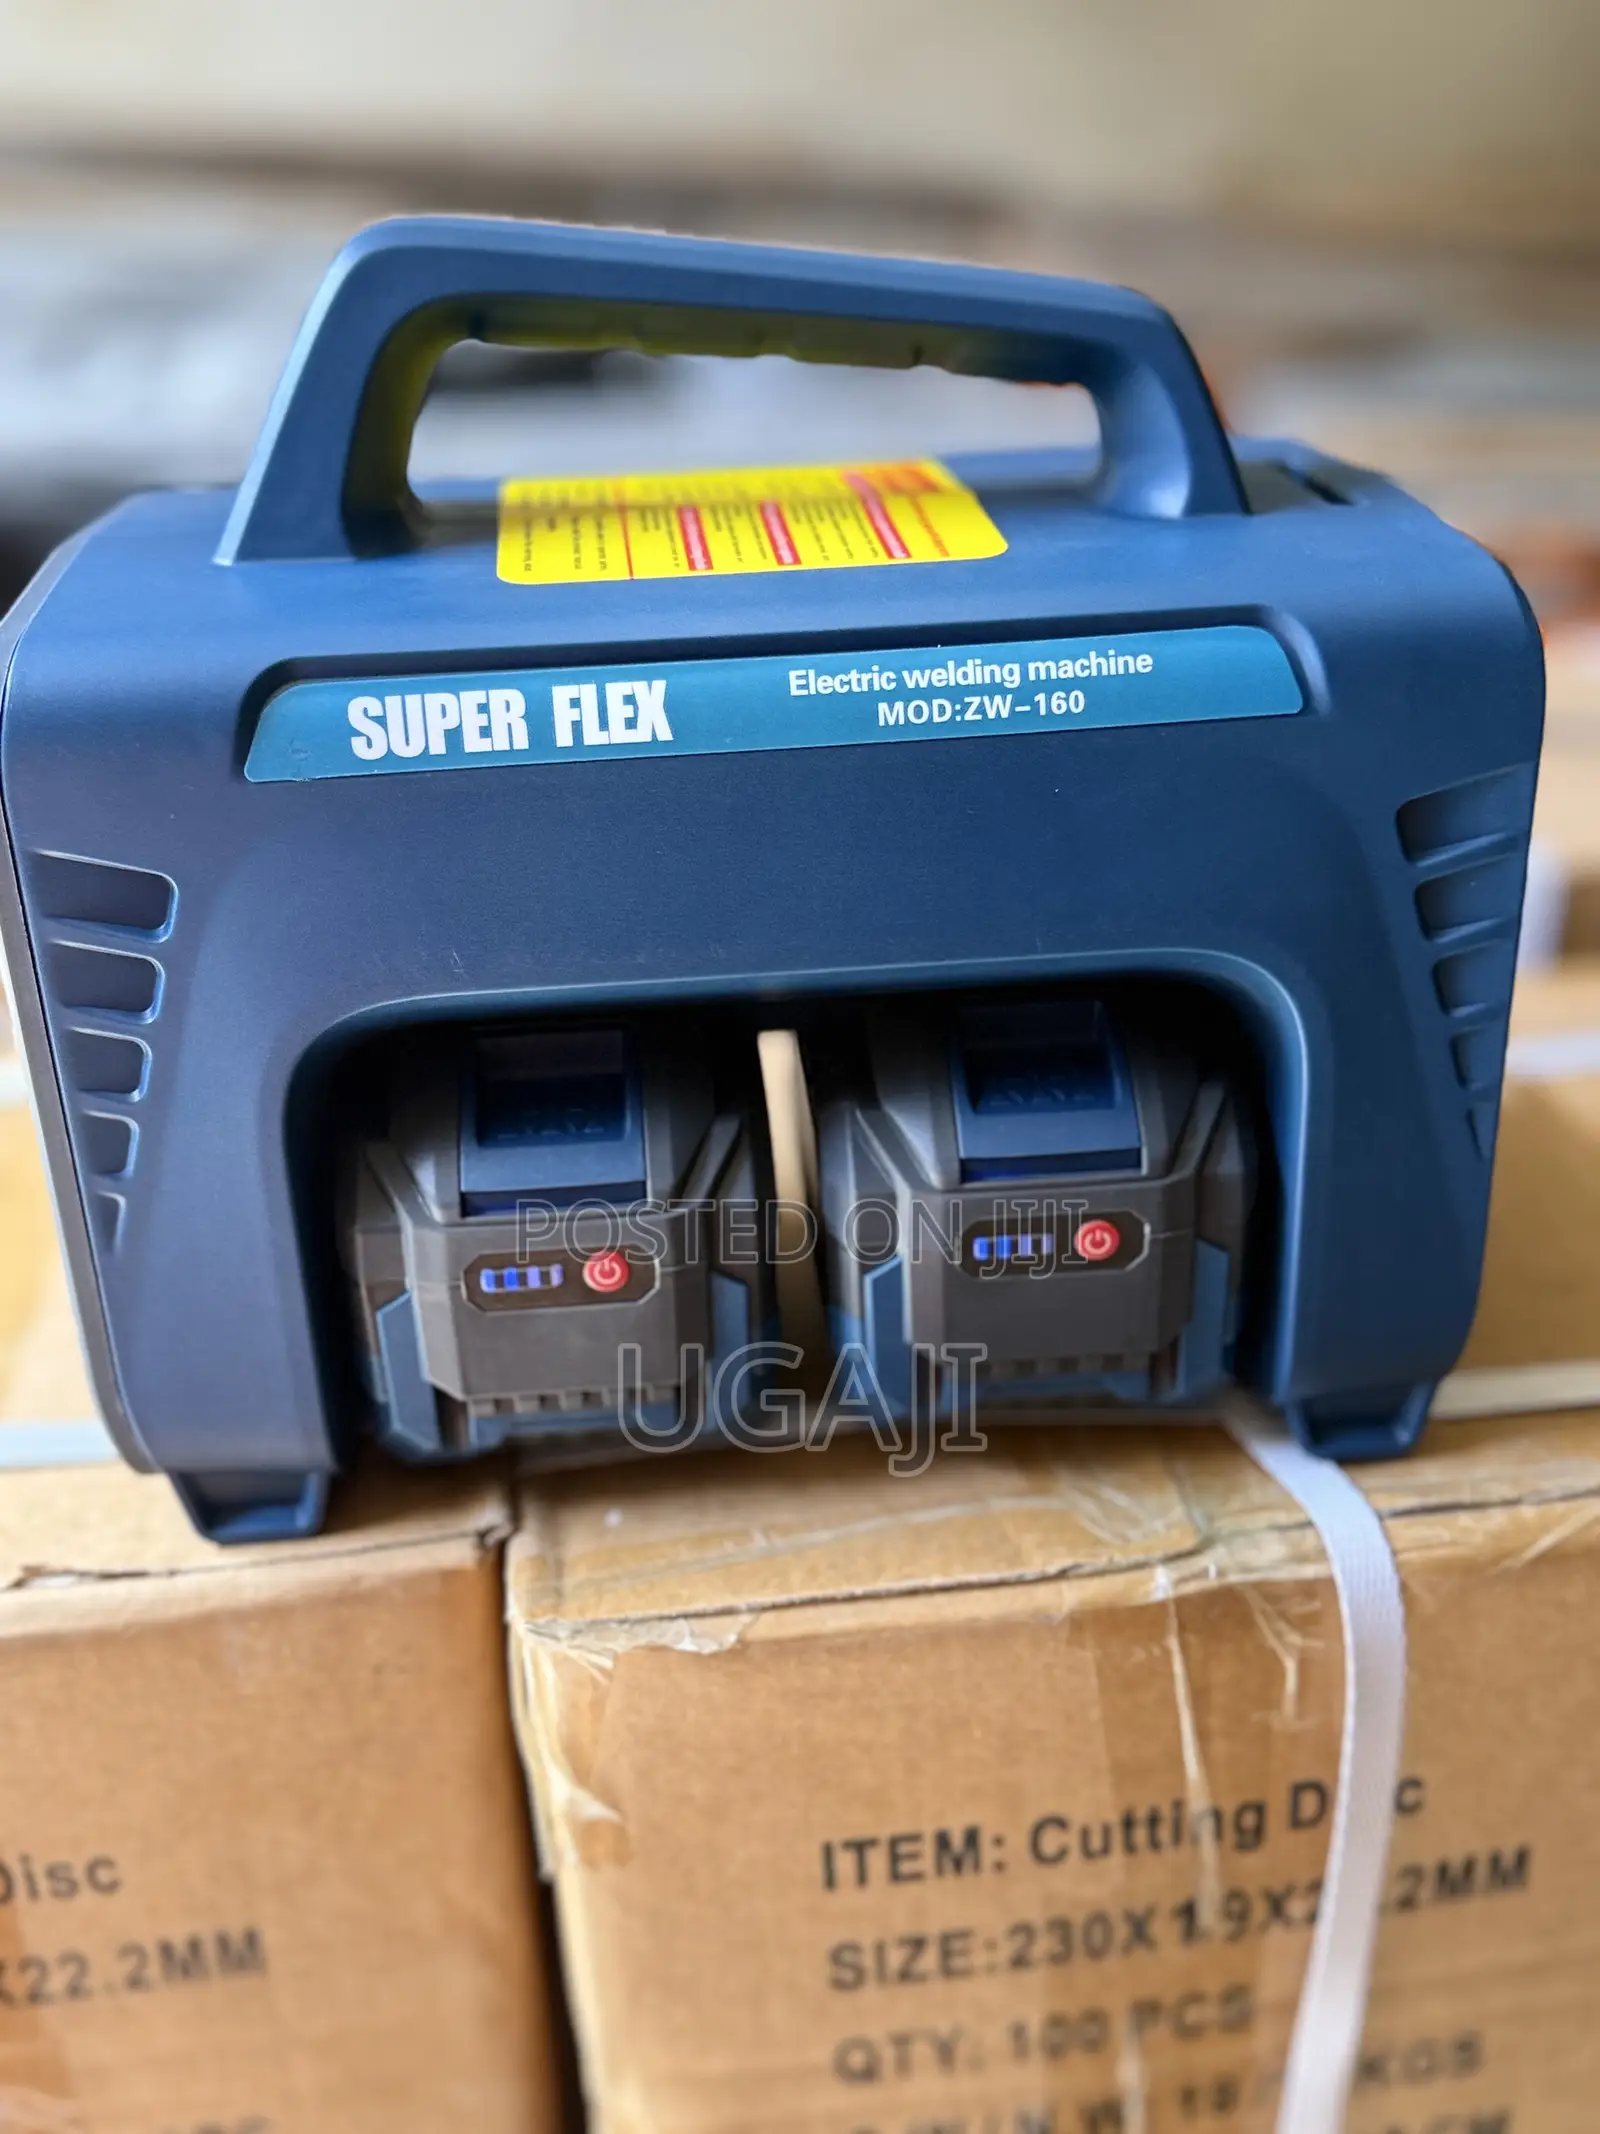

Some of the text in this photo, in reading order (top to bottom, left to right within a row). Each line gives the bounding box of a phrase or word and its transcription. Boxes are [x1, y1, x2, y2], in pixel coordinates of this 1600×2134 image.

[788, 648, 1154, 697] Electric welding machine
[347, 679, 674, 760] SUPER FLEX
[877, 690, 1086, 727] MOD:ZW-160
[821, 1777, 1426, 1891] ITEM: Cutting Dc
